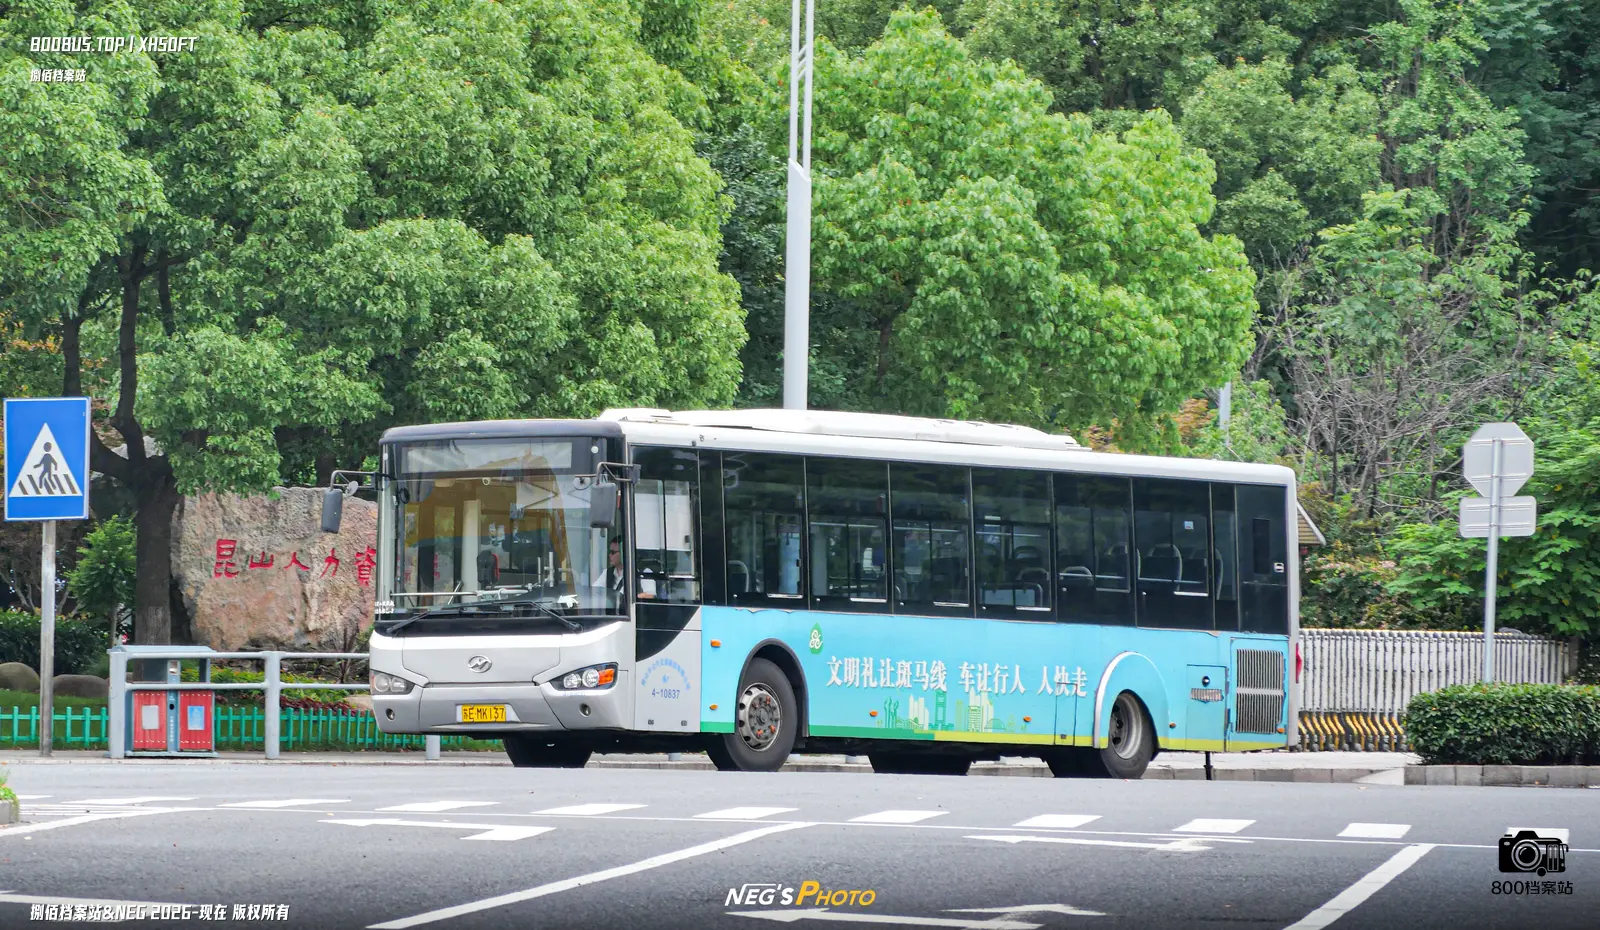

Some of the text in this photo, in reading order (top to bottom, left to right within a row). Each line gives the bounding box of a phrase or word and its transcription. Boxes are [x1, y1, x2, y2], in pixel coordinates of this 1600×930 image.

[826, 655, 1088, 698] 文明礼让斑马线 车让行人 人快走
[651, 688, 681, 700] 4-10837
